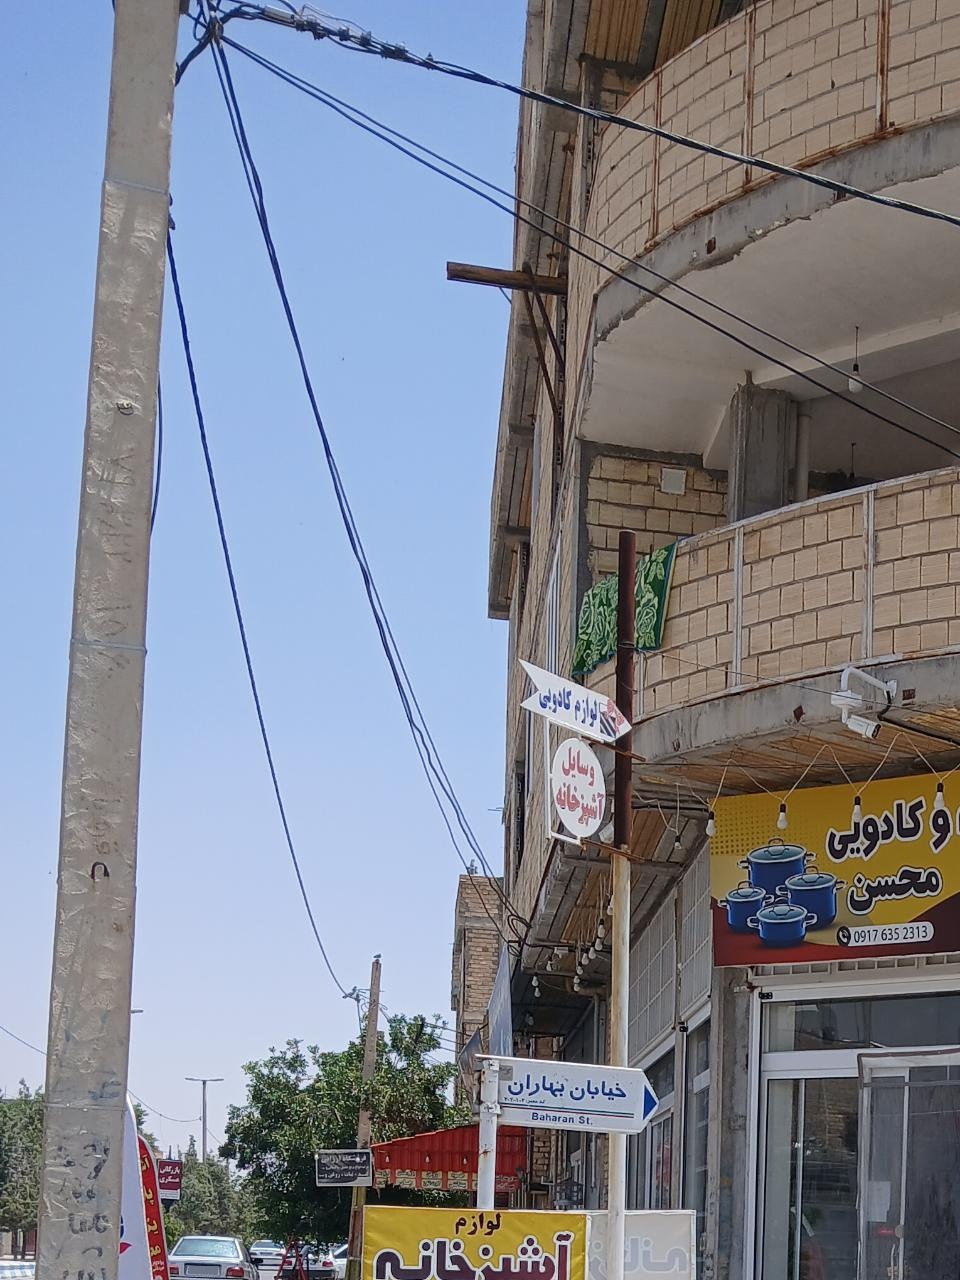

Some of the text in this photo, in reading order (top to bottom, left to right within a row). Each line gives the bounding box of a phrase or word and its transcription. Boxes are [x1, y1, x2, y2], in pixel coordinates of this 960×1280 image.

[538, 686, 598, 727] لوازم کادویی
[561, 746, 595, 787] وسایل
[555, 782, 605, 825] آشپزخانه
[827, 799, 925, 860] کادویی
[931, 808, 951, 851] و
[848, 867, 941, 911] محسن
[853, 924, 928, 943] 0917 635 2313
[507, 1074, 627, 1101] خیابان بهاران
[531, 1112, 593, 1125] Baharan St.
[454, 1213, 502, 1236] لوازم
